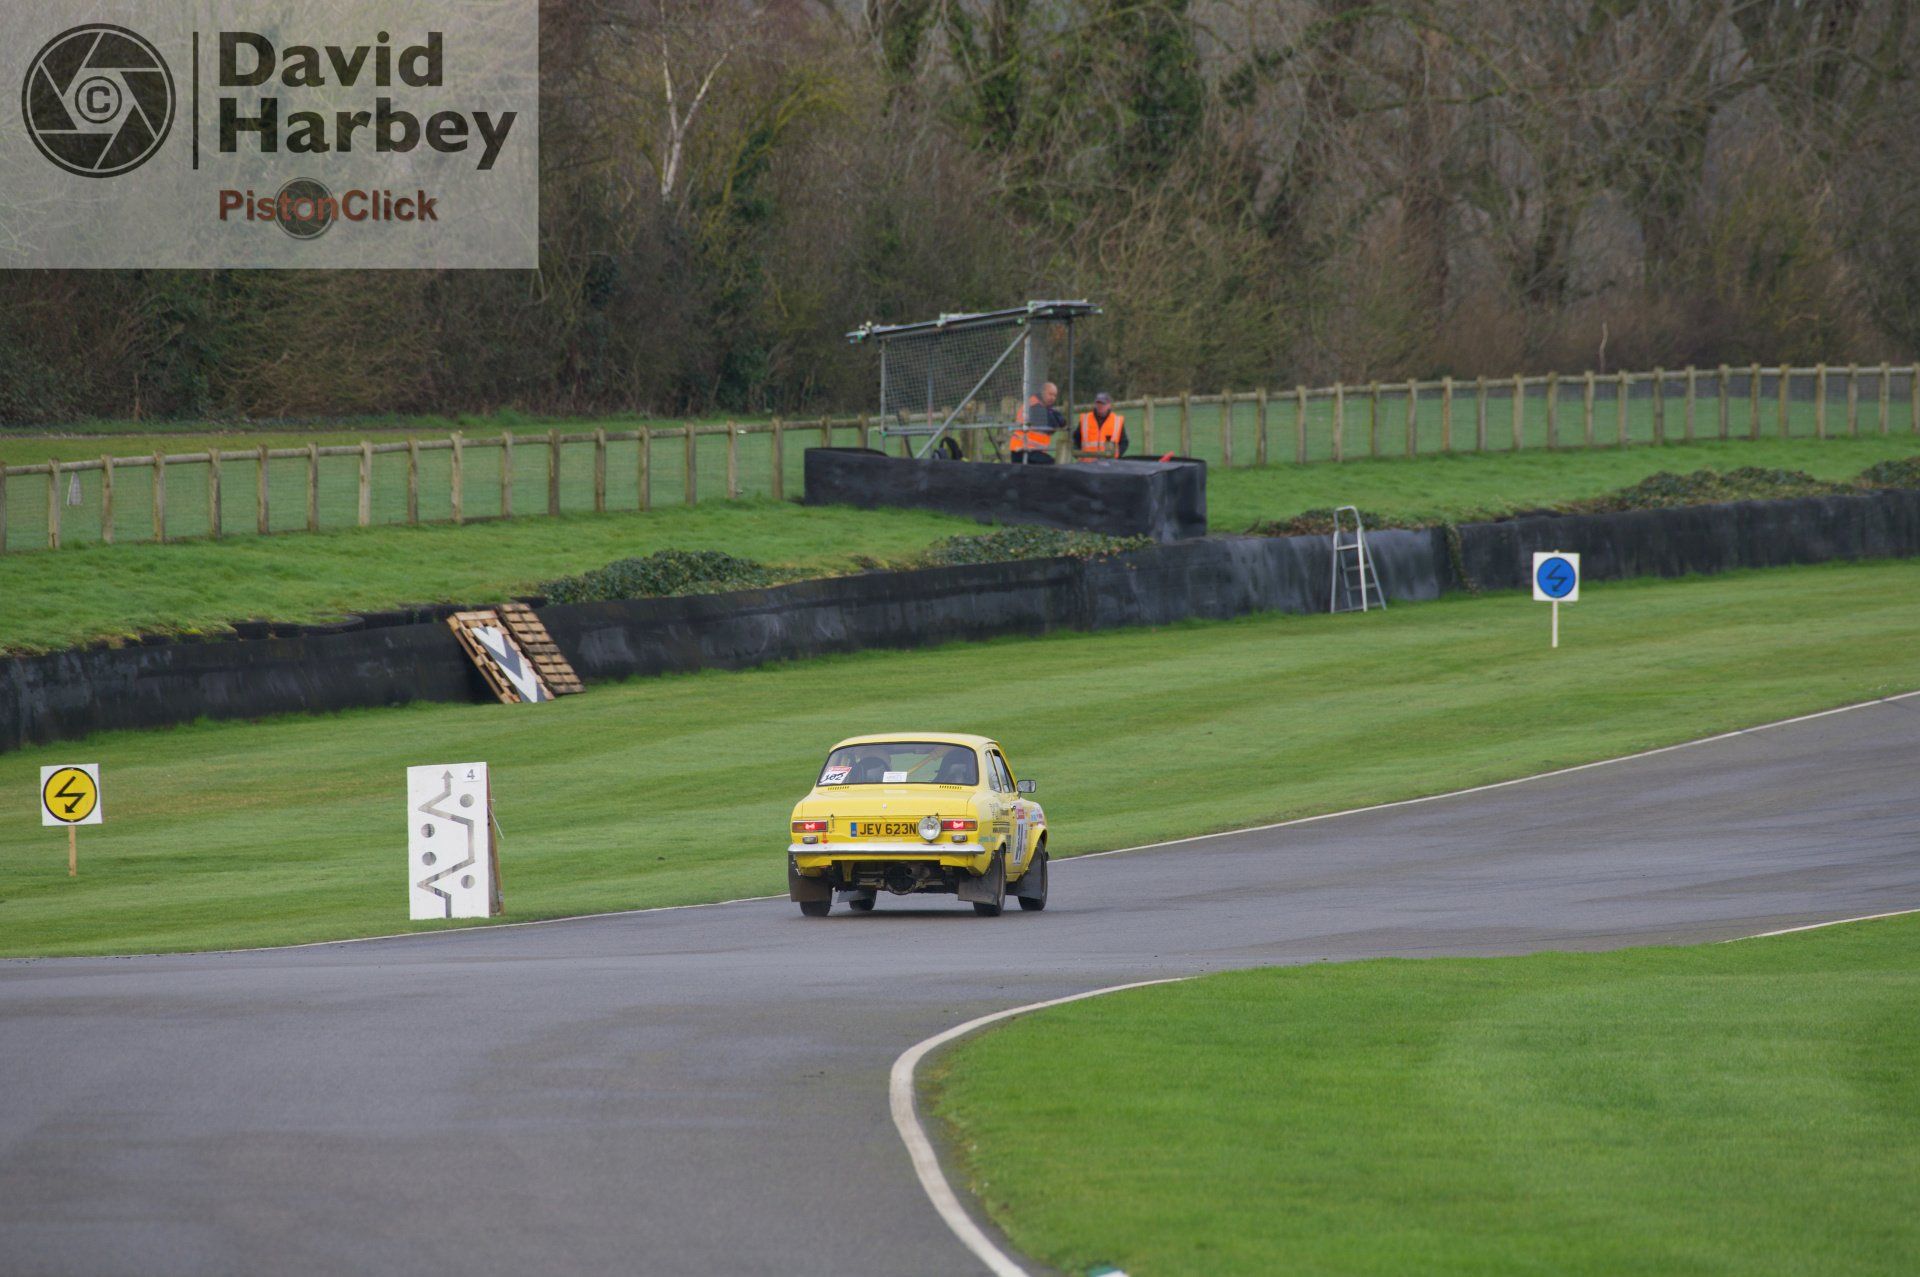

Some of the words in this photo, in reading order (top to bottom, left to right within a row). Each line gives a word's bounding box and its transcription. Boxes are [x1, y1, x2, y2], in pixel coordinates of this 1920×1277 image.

[467, 769, 475, 779] 4
[859, 823, 882, 835] JEV
[885, 823, 917, 835] 623N
